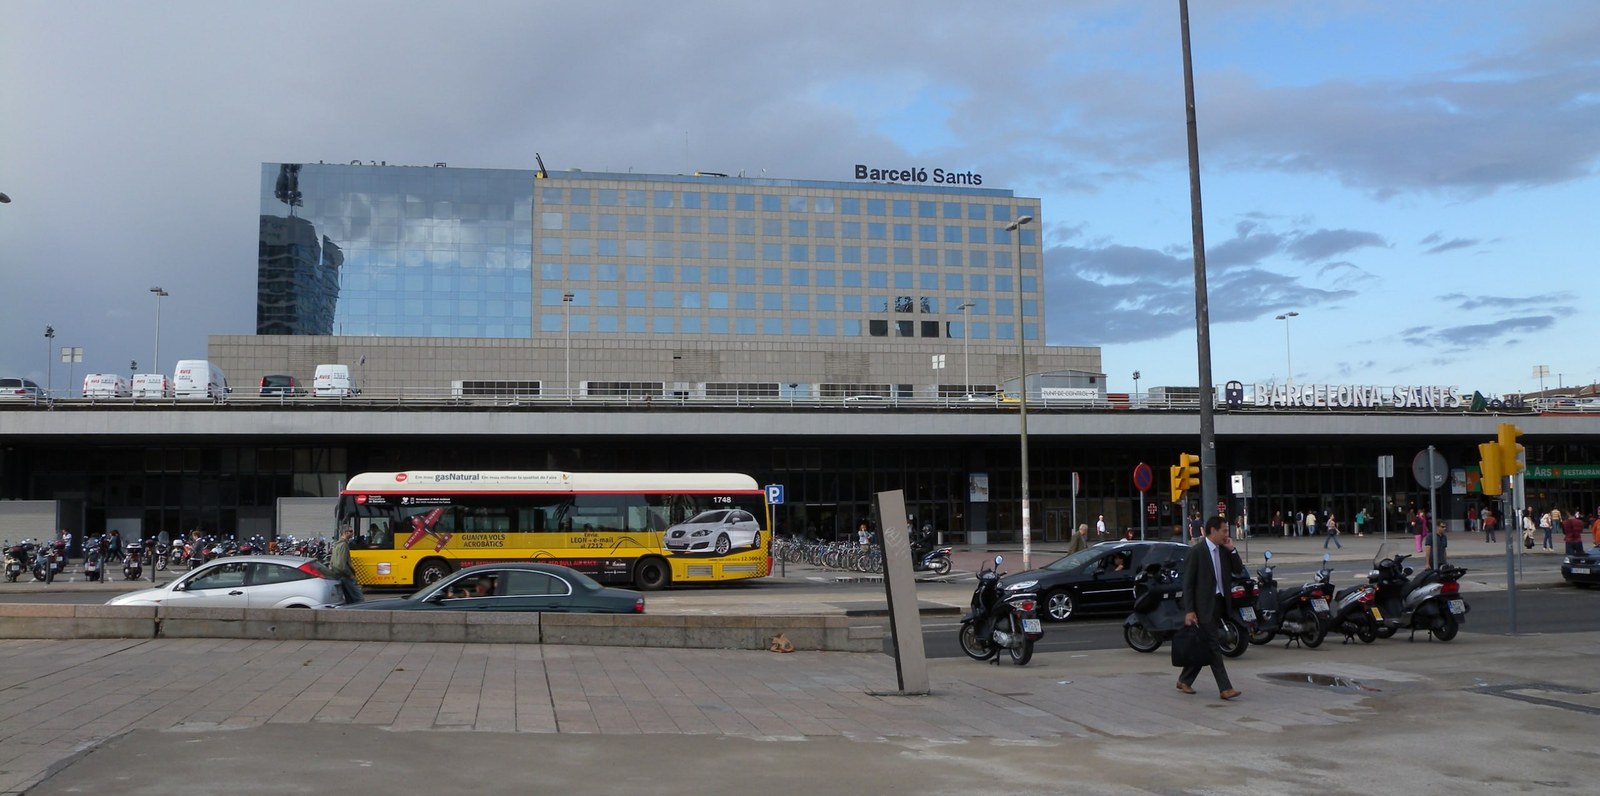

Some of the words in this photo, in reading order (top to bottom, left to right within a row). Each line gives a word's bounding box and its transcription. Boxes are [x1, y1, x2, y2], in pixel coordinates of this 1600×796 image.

[855, 164, 928, 183] Barceló
[933, 168, 983, 186] Sants
[1254, 383, 1383, 408] BARCELONA
[1393, 385, 1461, 408] SANTS
[434, 473, 480, 483] gasNatural
[769, 487, 780, 502] P
